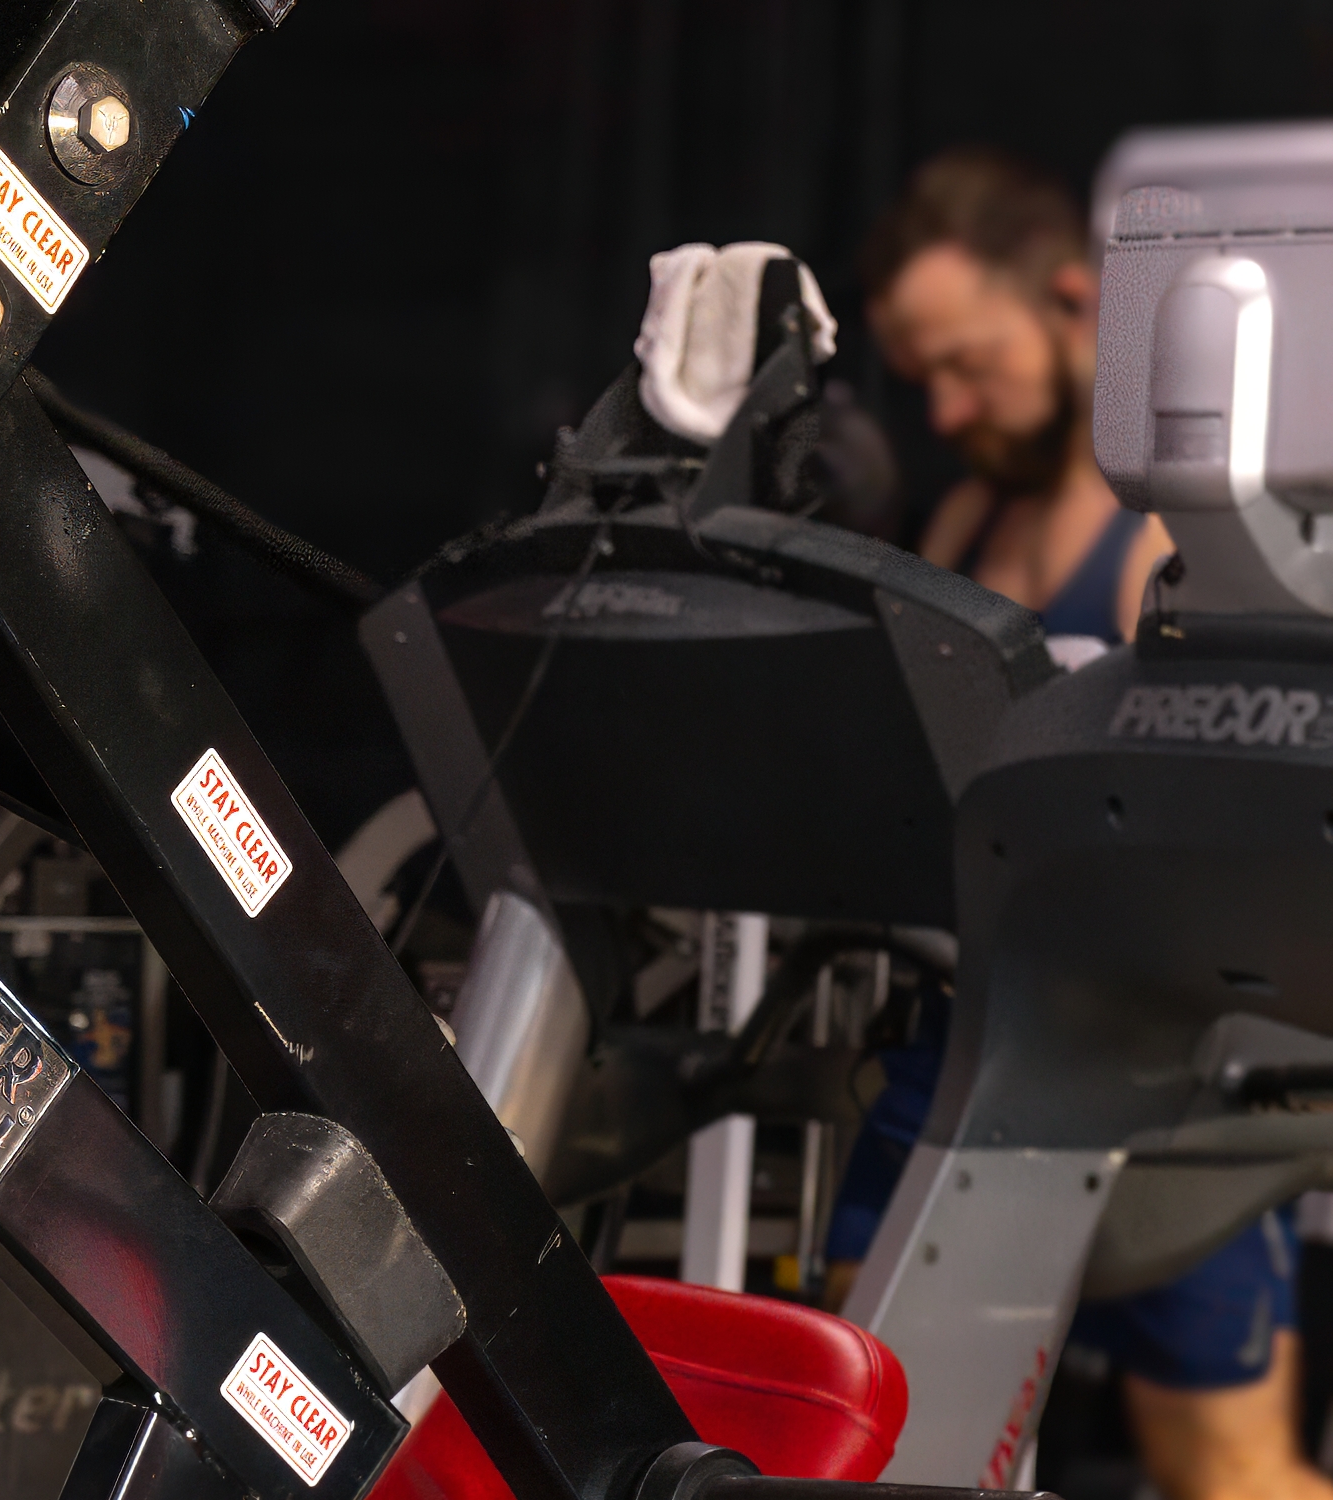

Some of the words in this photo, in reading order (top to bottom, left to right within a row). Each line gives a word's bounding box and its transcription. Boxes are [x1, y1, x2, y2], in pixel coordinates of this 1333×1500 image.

[22, 211, 74, 275] CLEAR
[200, 769, 239, 821] STAY
[236, 822, 278, 883] CLEAR
[249, 1353, 293, 1400] STAY
[290, 1395, 337, 1450] CLEAR
